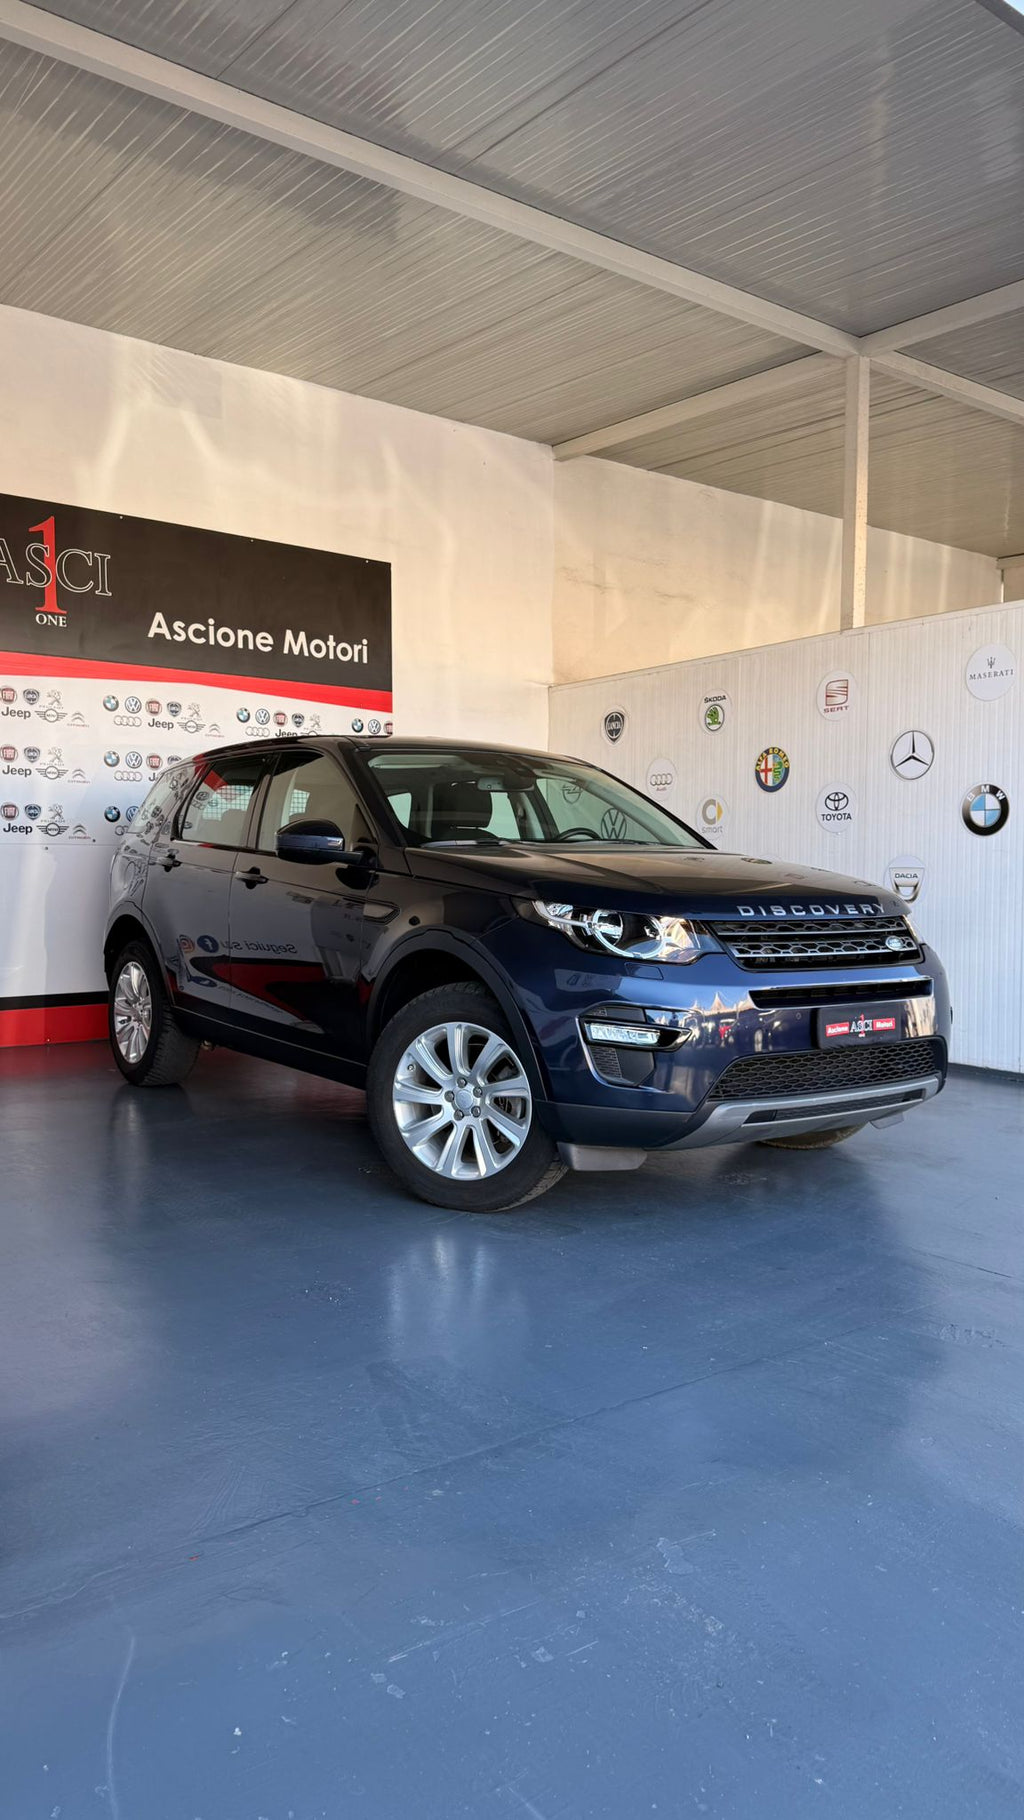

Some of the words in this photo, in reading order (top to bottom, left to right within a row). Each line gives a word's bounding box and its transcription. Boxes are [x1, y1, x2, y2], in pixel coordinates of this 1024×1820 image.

[35, 613, 67, 628] ONE
[147, 611, 274, 652] Ascione
[283, 629, 368, 663] Motori
[969, 669, 1014, 680] MASERATI
[1, 706, 31, 720] Jeep
[823, 705, 850, 713] SEAT
[148, 718, 174, 730] Jeep
[2, 765, 32, 777] Jeep
[966, 784, 1006, 801] BMW
[821, 813, 852, 822] TOYOTA
[3, 823, 33, 835] Jeep
[702, 825, 723, 834] smart
[737, 903, 885, 917] DISCOVERY
[850, 1020, 872, 1032] ASCI
